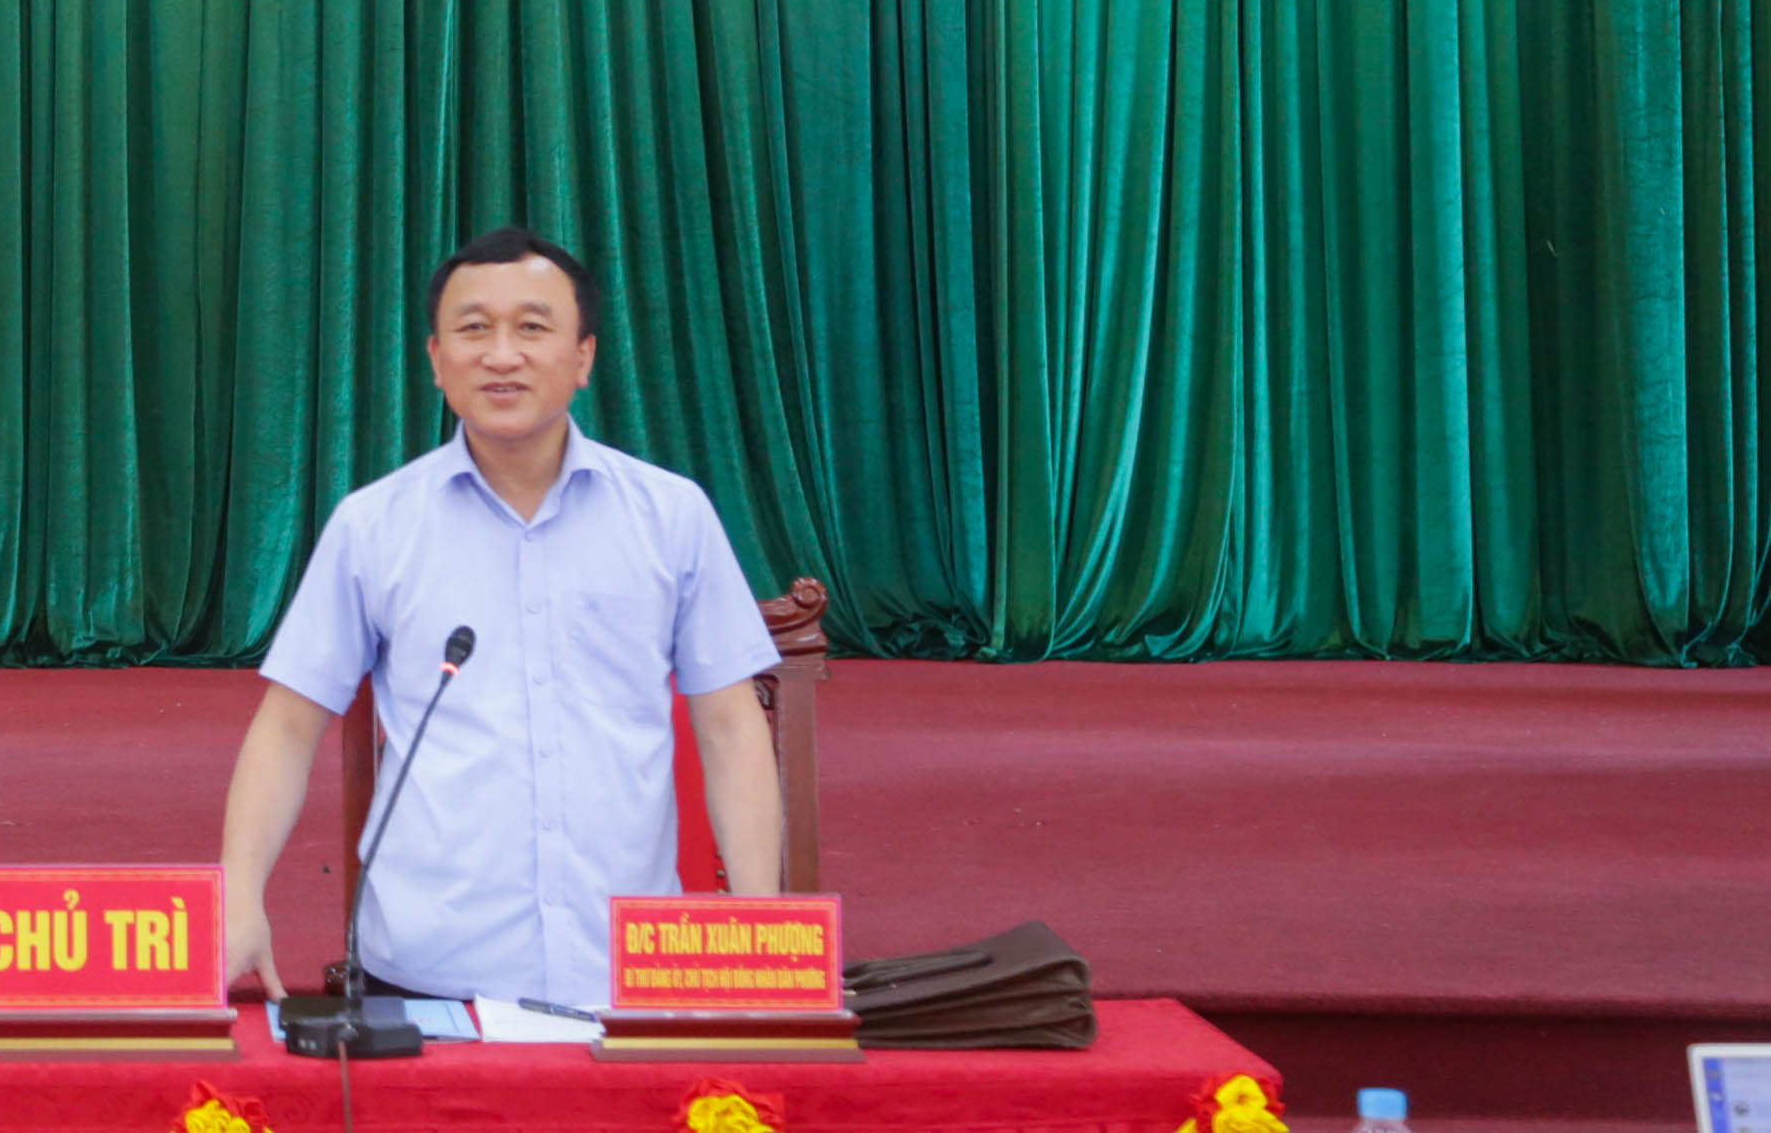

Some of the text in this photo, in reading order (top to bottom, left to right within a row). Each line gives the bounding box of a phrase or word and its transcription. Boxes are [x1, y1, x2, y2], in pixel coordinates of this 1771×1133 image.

[103, 896, 190, 971] TRÌ
[625, 922, 656, 955] Đ/C
[705, 917, 753, 955] XUÂN
[754, 920, 825, 962] PHƯỢNG
